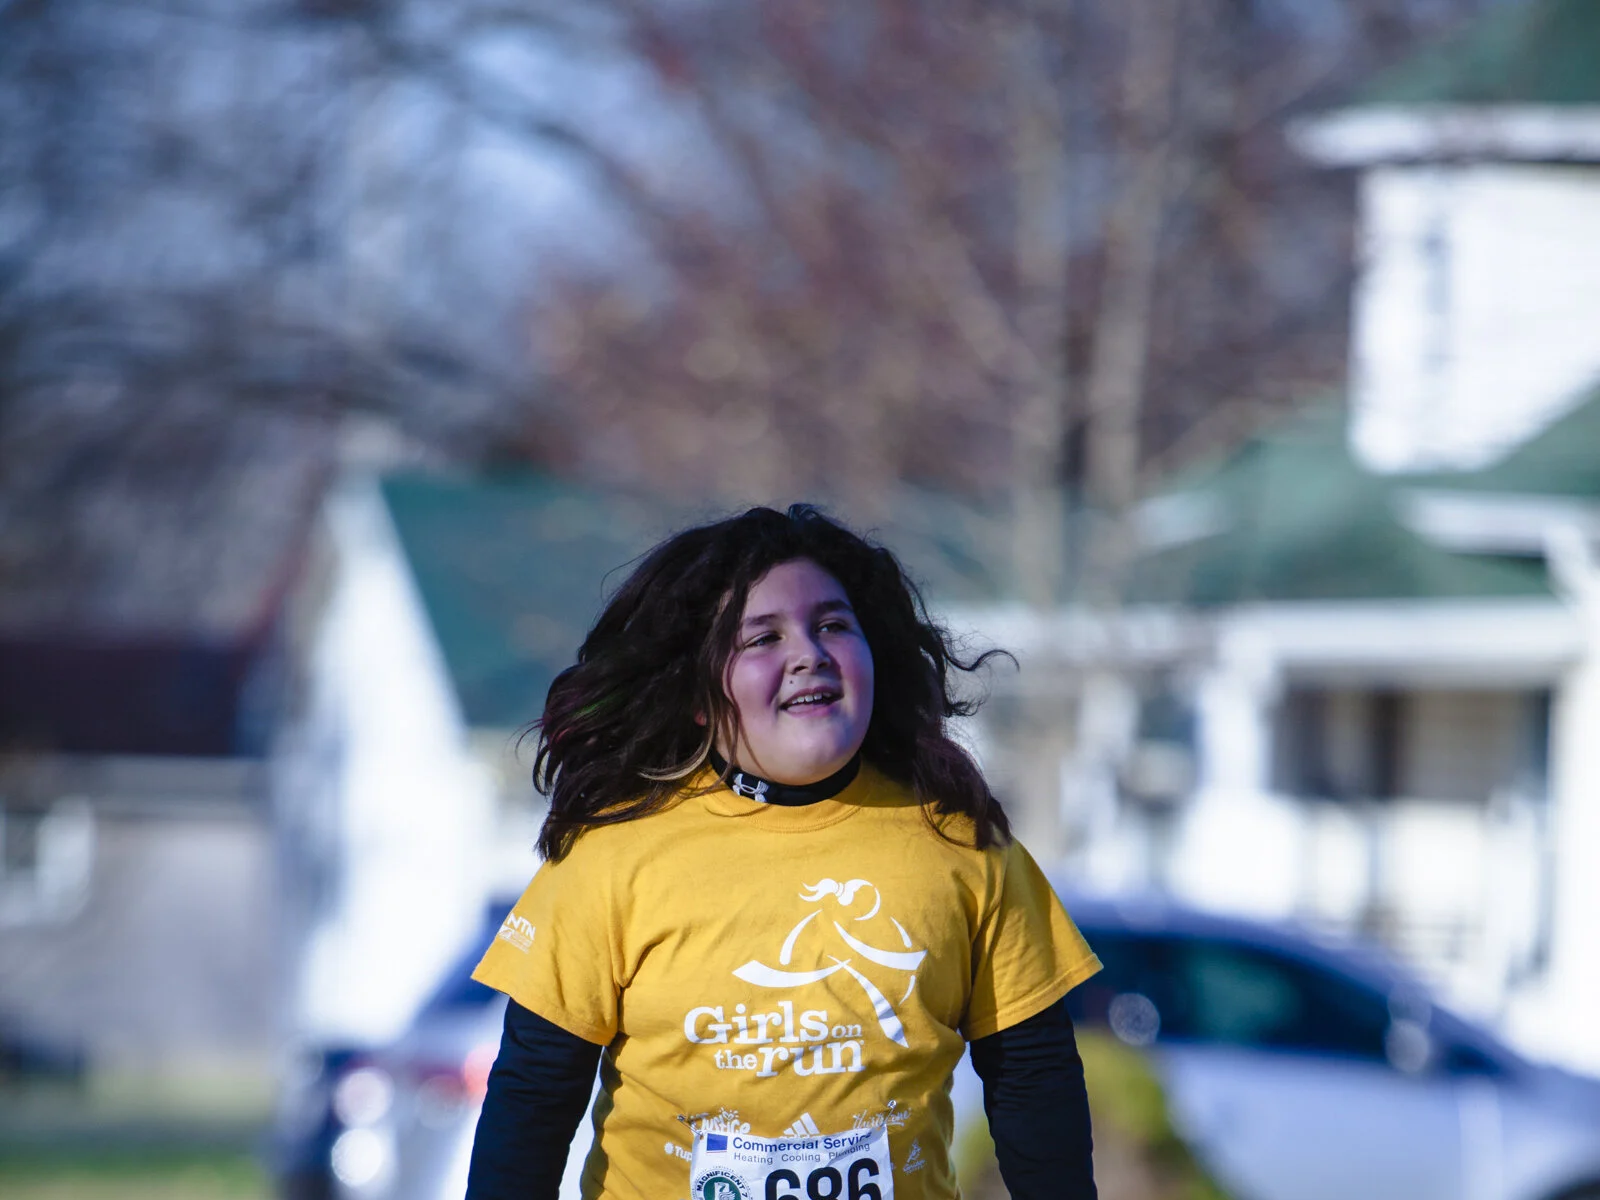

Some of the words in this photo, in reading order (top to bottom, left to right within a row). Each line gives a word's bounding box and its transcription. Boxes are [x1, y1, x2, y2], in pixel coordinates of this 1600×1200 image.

[683, 1000, 829, 1045] Girls
[831, 1023, 862, 1039] on
[714, 1049, 757, 1070] the
[756, 1040, 866, 1078] run
[732, 1137, 819, 1153] Commercial
[733, 1152, 774, 1165] Heating
[781, 1153, 821, 1162] Cooling
[696, 1170, 745, 1192] MAGNIFICENT
